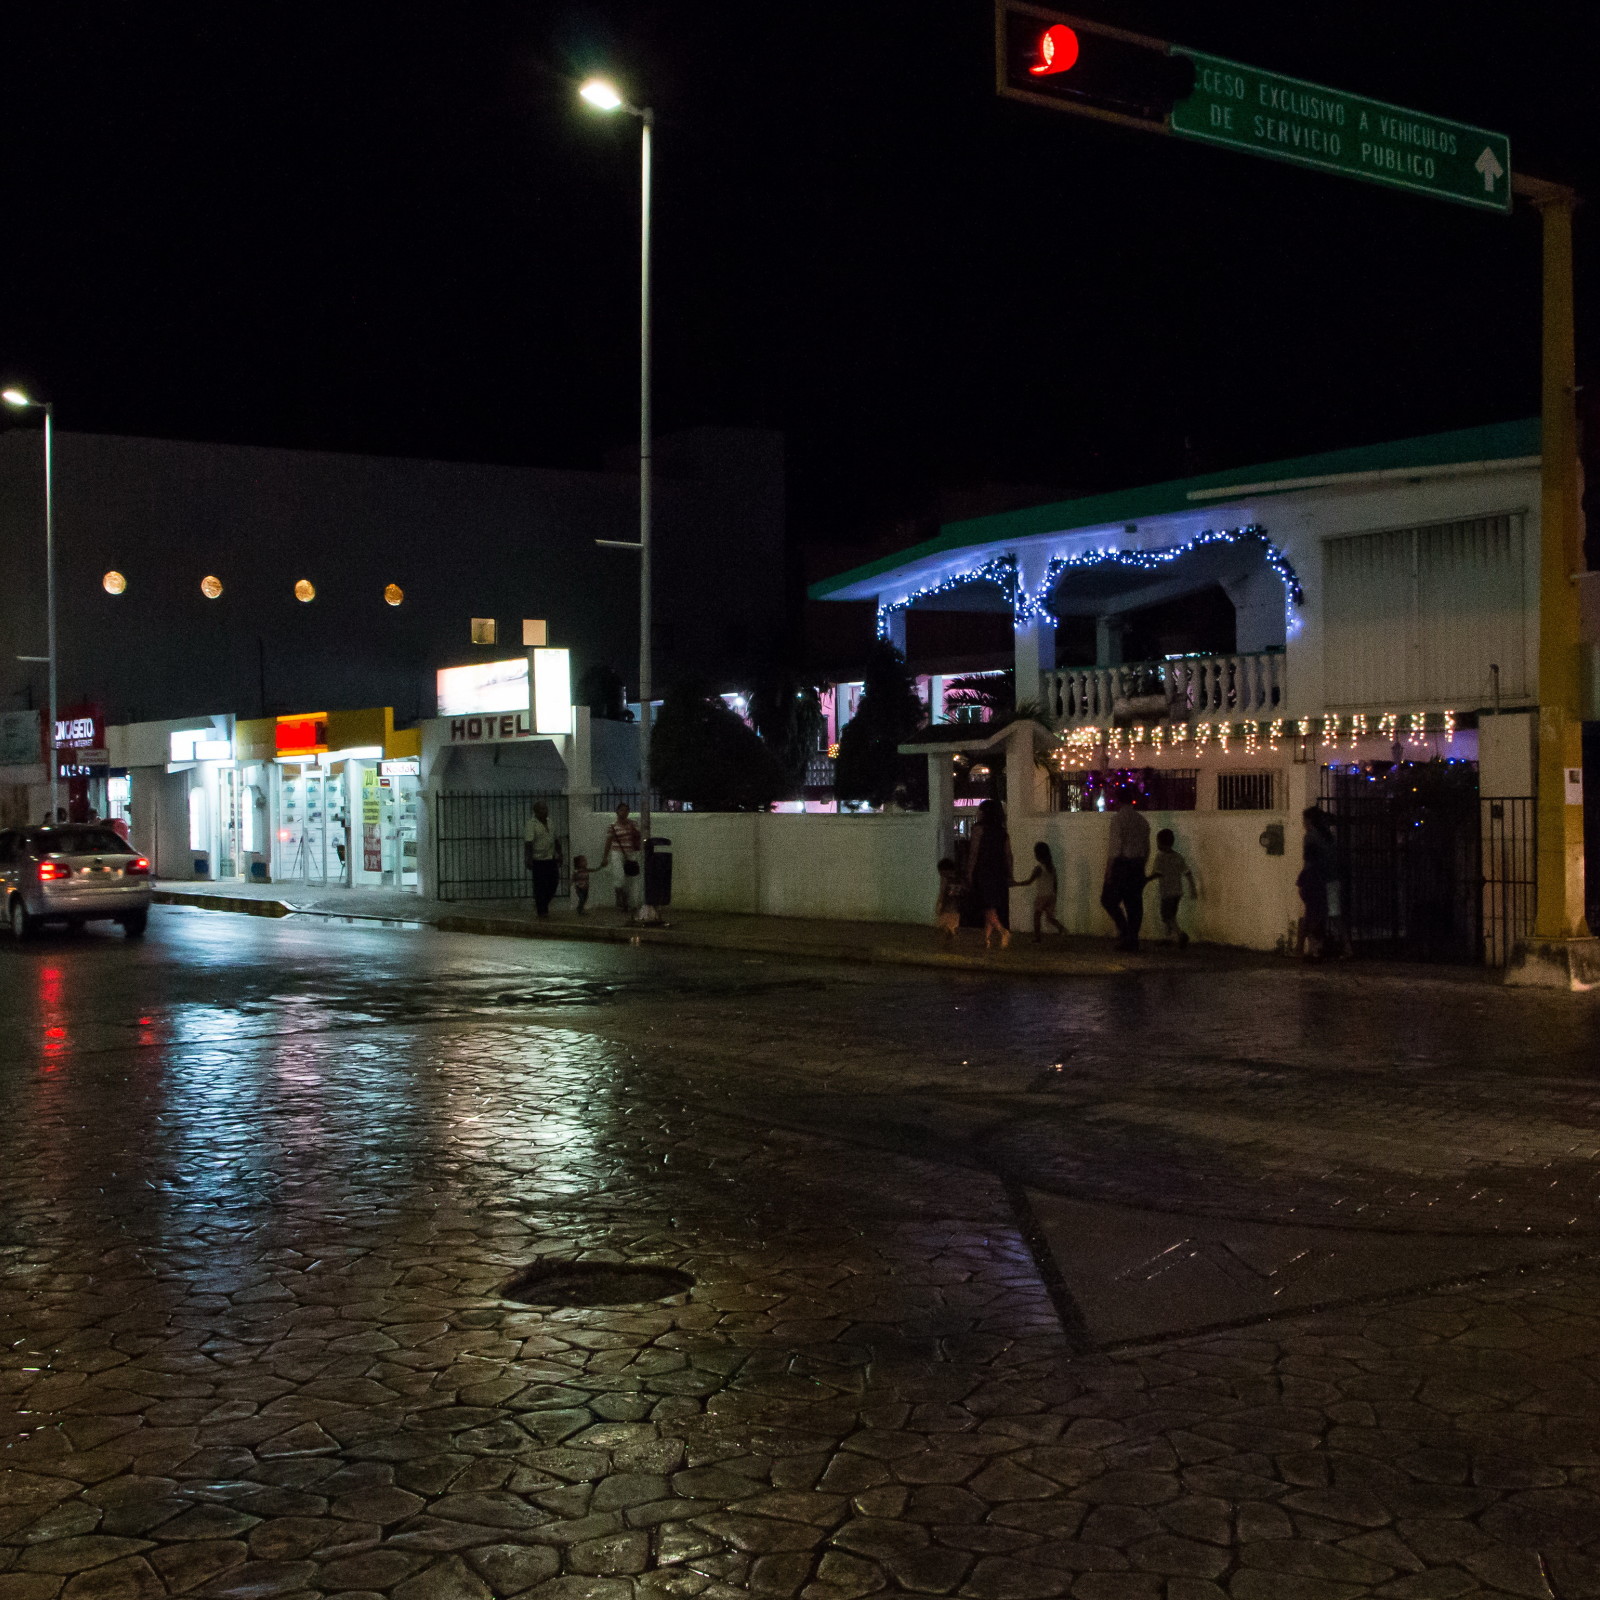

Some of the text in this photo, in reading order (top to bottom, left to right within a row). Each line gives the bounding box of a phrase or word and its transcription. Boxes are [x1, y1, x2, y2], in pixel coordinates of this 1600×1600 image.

[1210, 104, 1436, 179] DE SERVICIO PUBLICO
[1259, 83, 1345, 126] EXCLUSIVO
[1359, 111, 1369, 130] A
[1380, 115, 1457, 155] VEHICULOS
[451, 714, 531, 741] HOTEL
